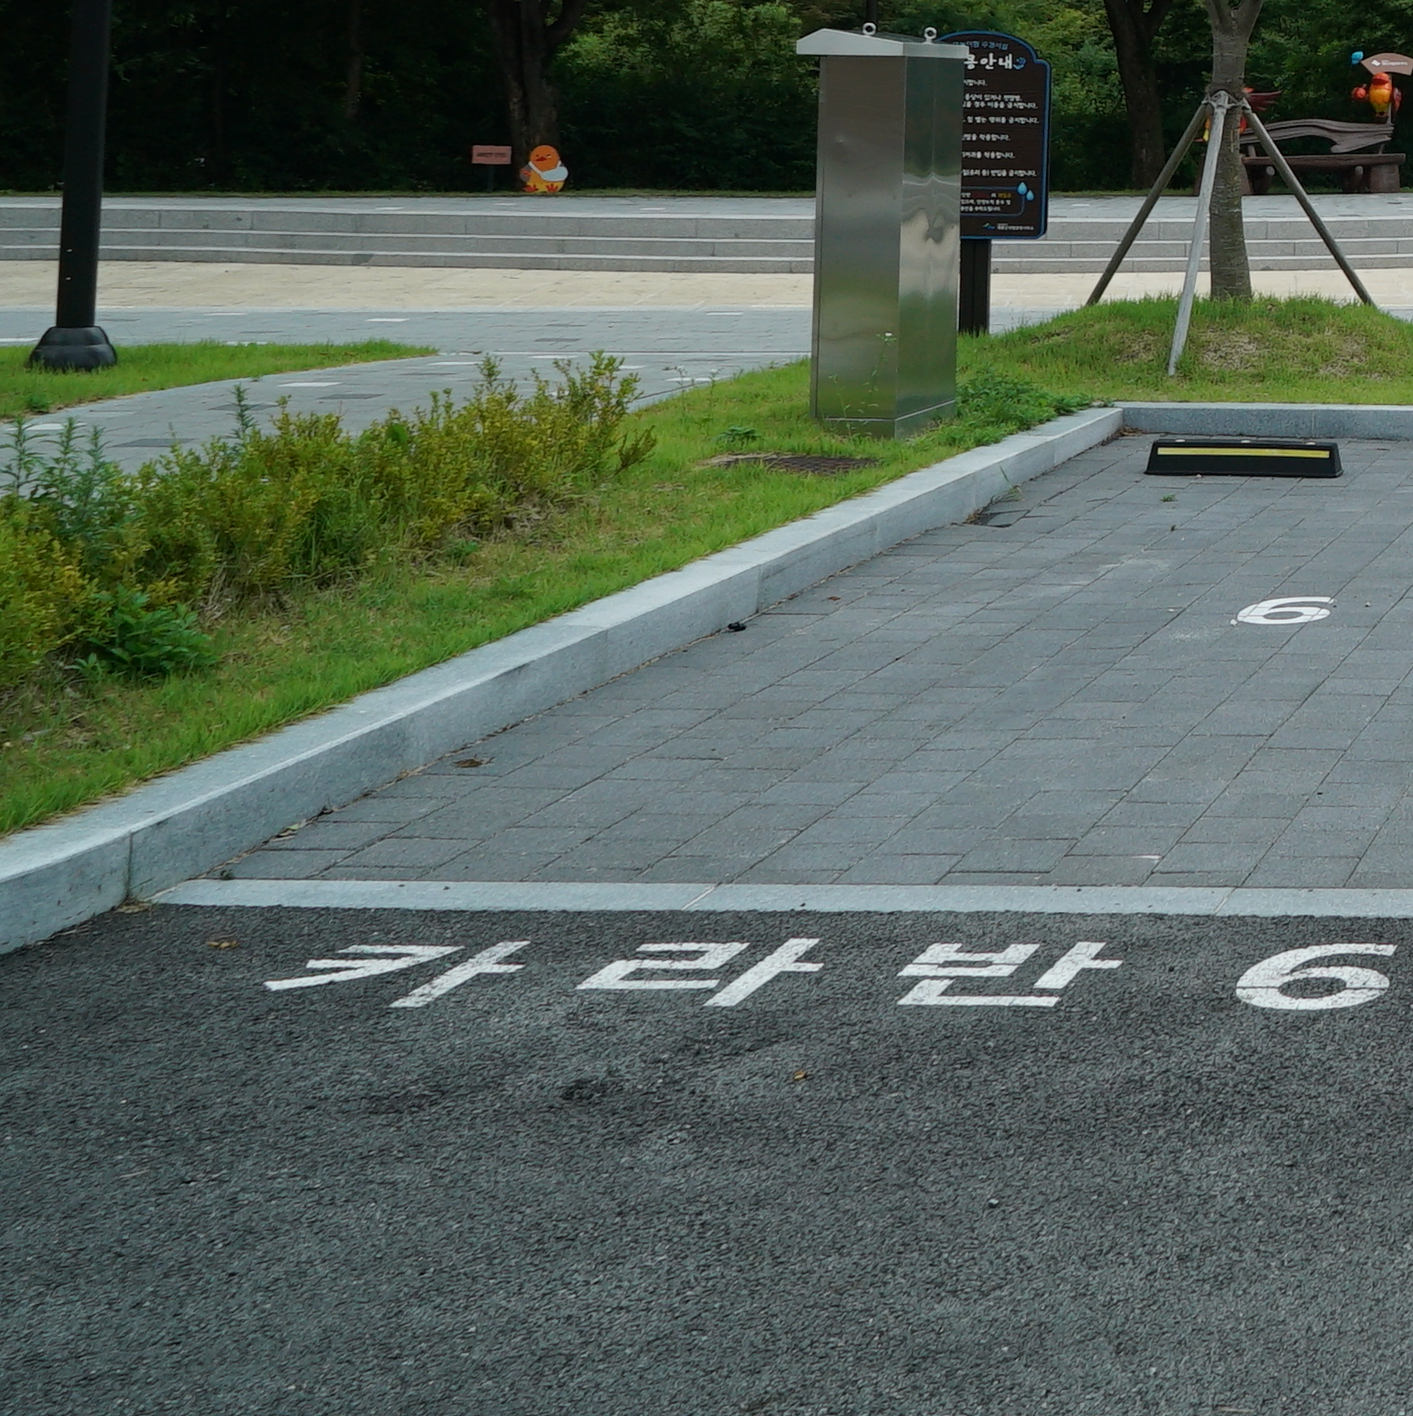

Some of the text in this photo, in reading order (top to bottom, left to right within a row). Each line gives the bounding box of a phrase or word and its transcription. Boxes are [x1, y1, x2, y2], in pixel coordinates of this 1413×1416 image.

[1238, 597, 1334, 624] 6
[264, 938, 1397, 1010] 카라반 6
